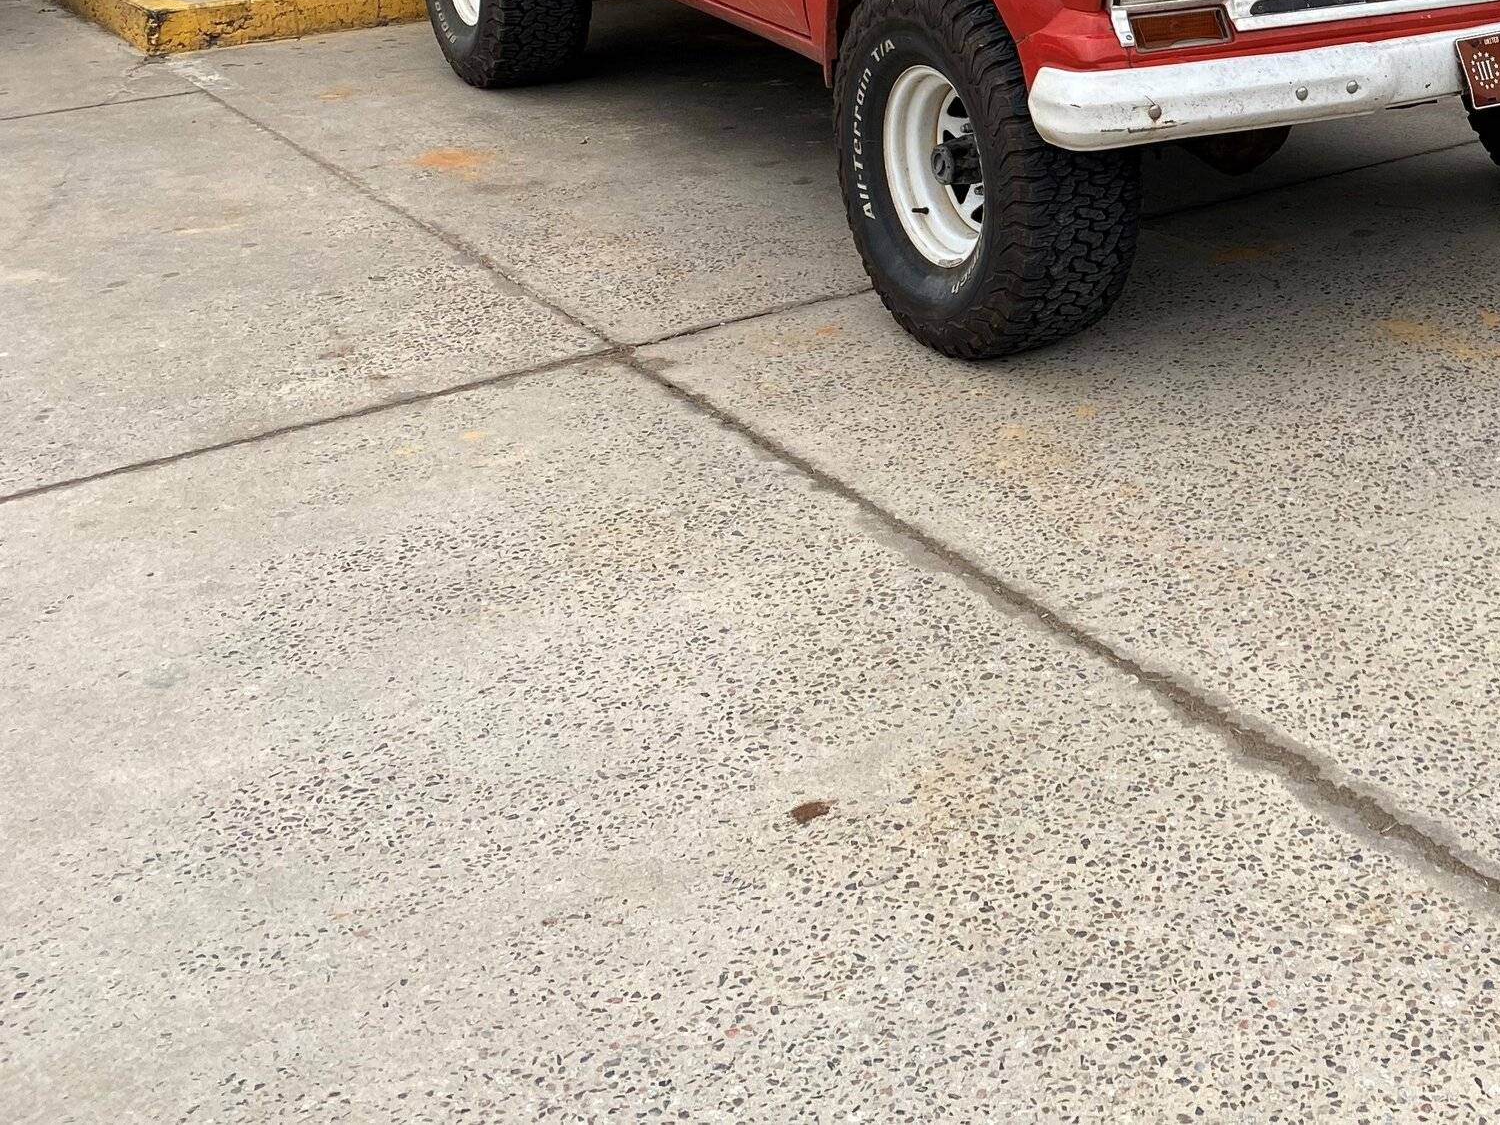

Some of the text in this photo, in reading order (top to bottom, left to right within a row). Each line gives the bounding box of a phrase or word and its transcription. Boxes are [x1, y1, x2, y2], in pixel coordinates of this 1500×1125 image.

[1483, 37, 1500, 45] UNITED
[853, 38, 896, 220] All-Terrain T/A
